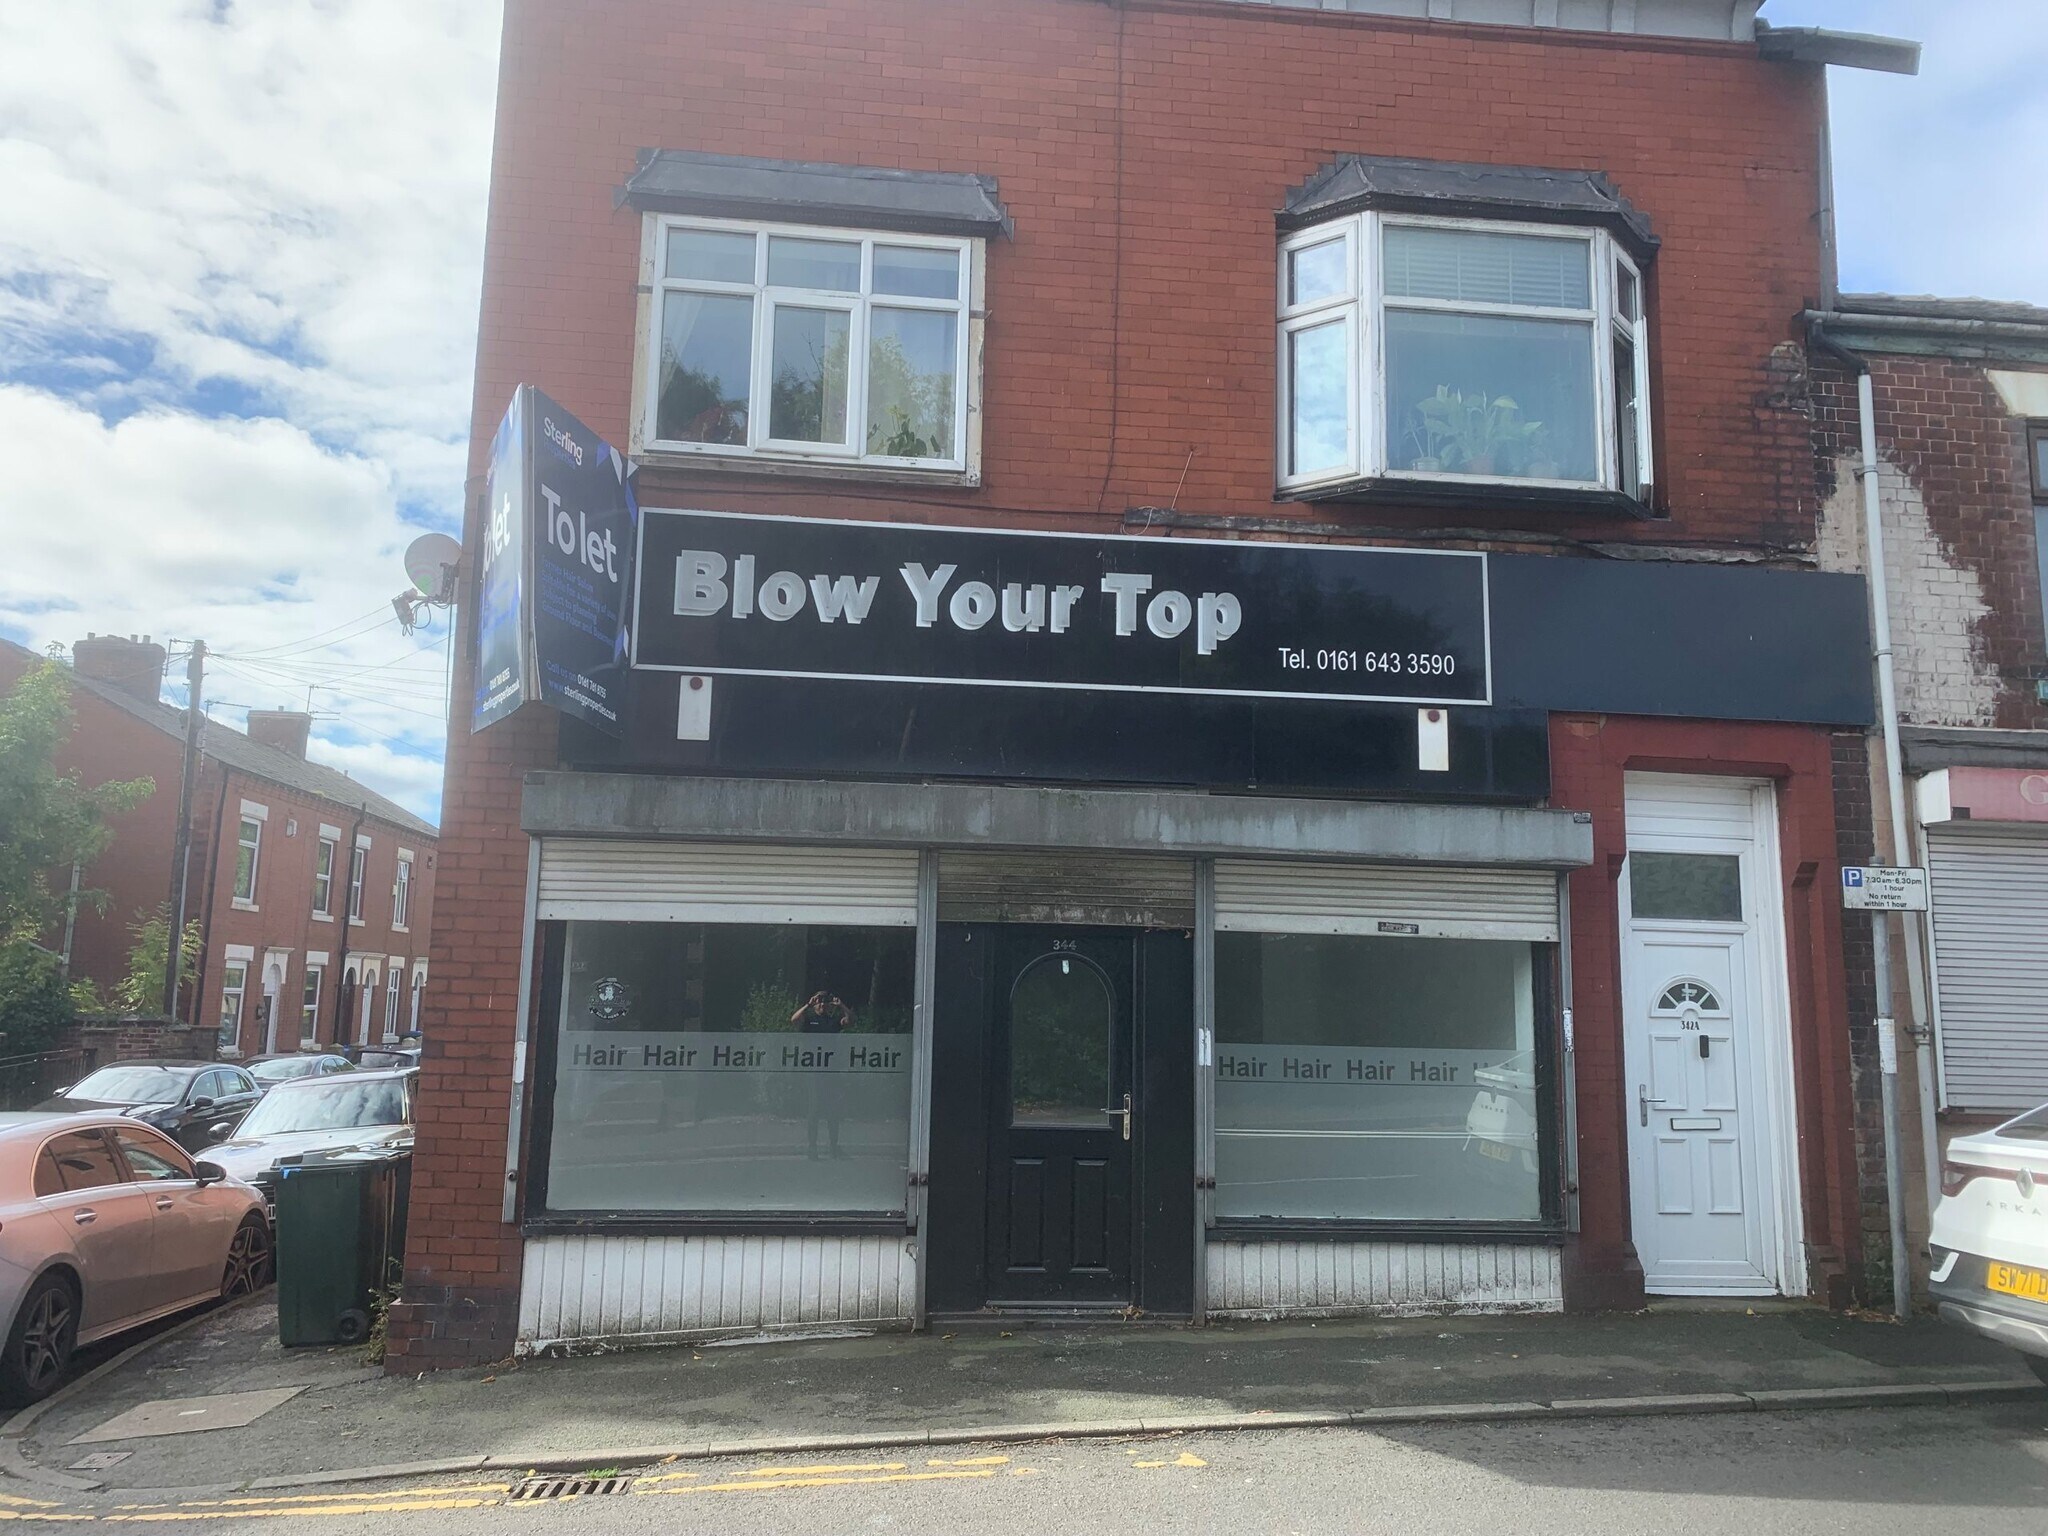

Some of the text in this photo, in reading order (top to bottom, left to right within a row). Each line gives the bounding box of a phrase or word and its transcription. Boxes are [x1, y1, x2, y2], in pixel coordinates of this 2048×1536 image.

[544, 417, 583, 466] Sterling
[492, 491, 511, 563] let
[541, 483, 617, 583] To let
[673, 549, 1242, 655] Blow Your Top
[1278, 647, 1455, 675] Tel. 0161 643 3590
[1053, 939, 1077, 950] 344
[1681, 1020, 1700, 1030] 342A
[572, 1044, 901, 1068] Hair Hair Hair Hair Hair
[1219, 1056, 1268, 1077] Hair
[1283, 1058, 1331, 1079] Hair
[1347, 1059, 1395, 1080] Hair
[1410, 1060, 1459, 1082] Hair
[1985, 1199, 2042, 1216] ARKA
